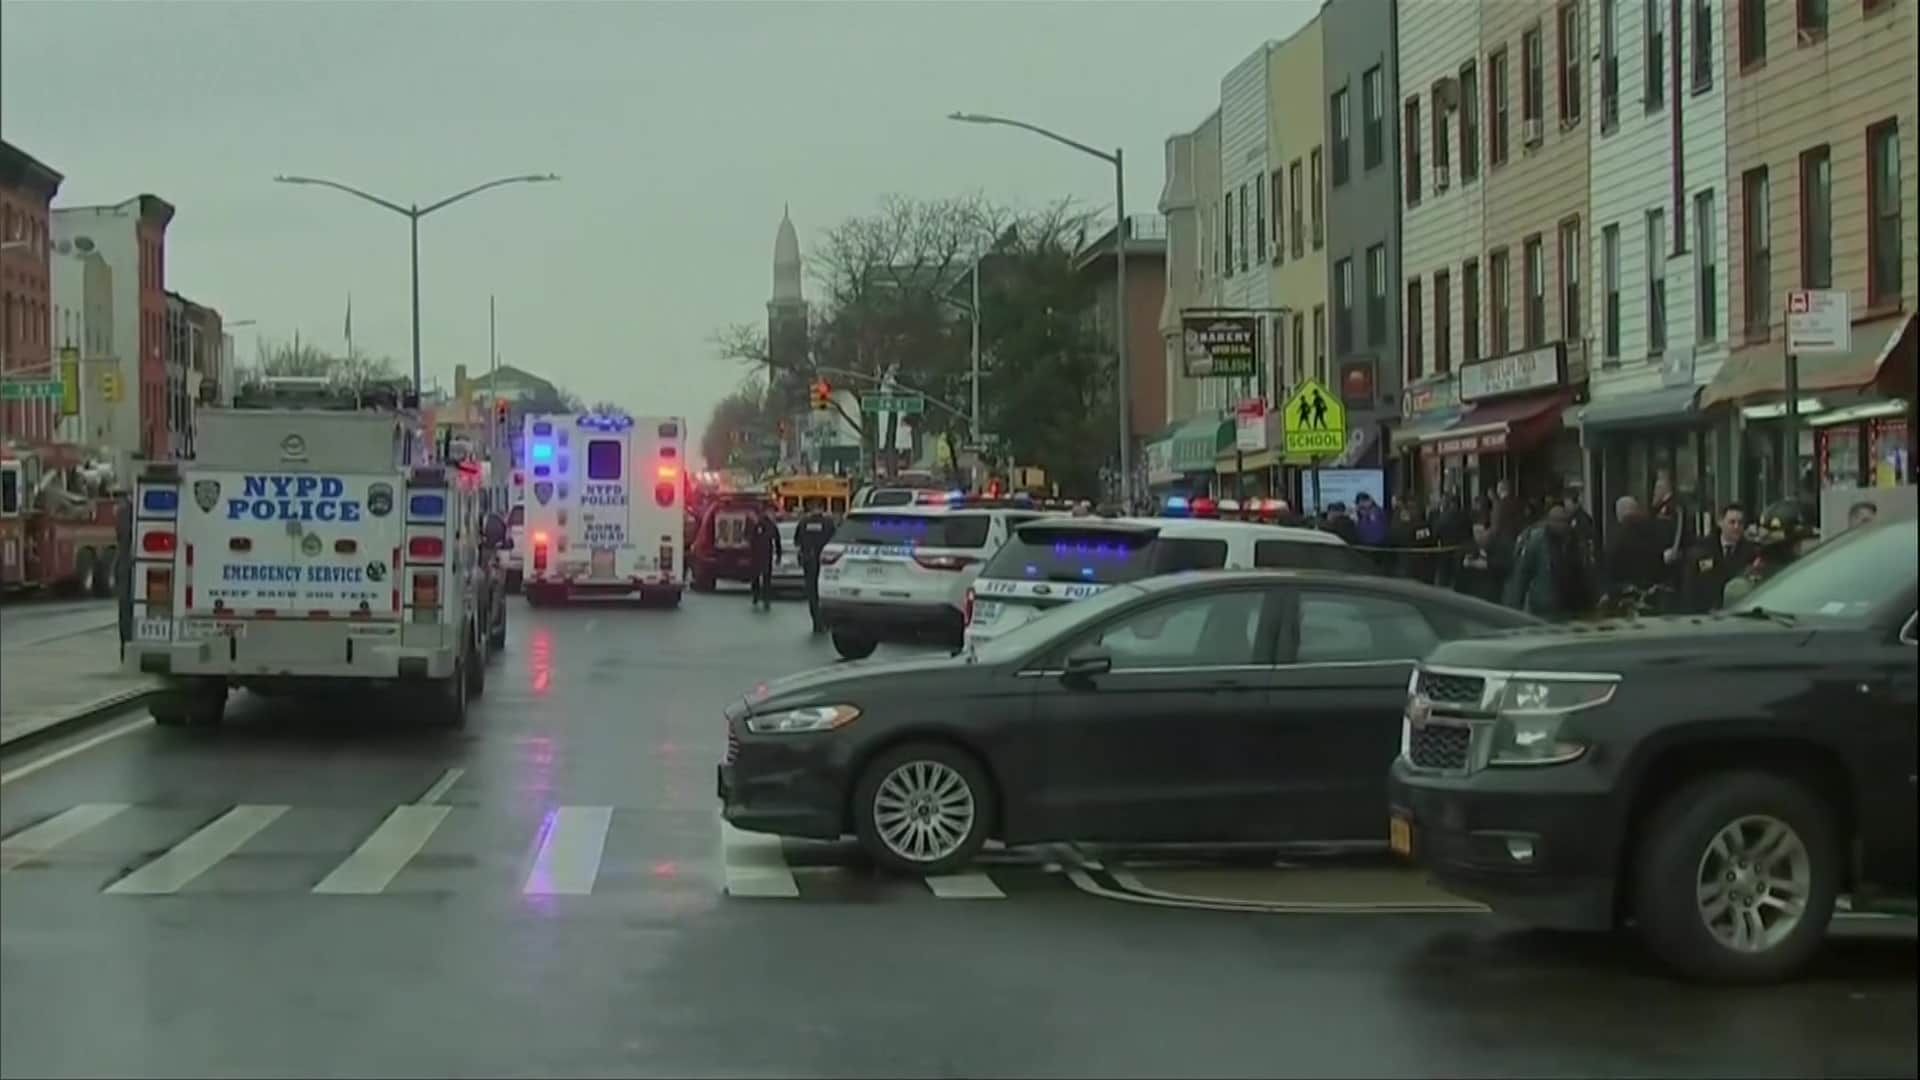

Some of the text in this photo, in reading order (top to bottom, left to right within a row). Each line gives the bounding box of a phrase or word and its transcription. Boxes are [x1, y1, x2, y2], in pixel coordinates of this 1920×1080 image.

[1199, 331, 1250, 343] BAKERY
[1289, 434, 1340, 447] SCHOOL
[243, 475, 344, 498] NYPD
[586, 485, 622, 495] NYPD
[581, 496, 625, 505] POLICE
[227, 499, 361, 522] POLICE
[223, 565, 362, 582] EMERGENCY SERVICE
